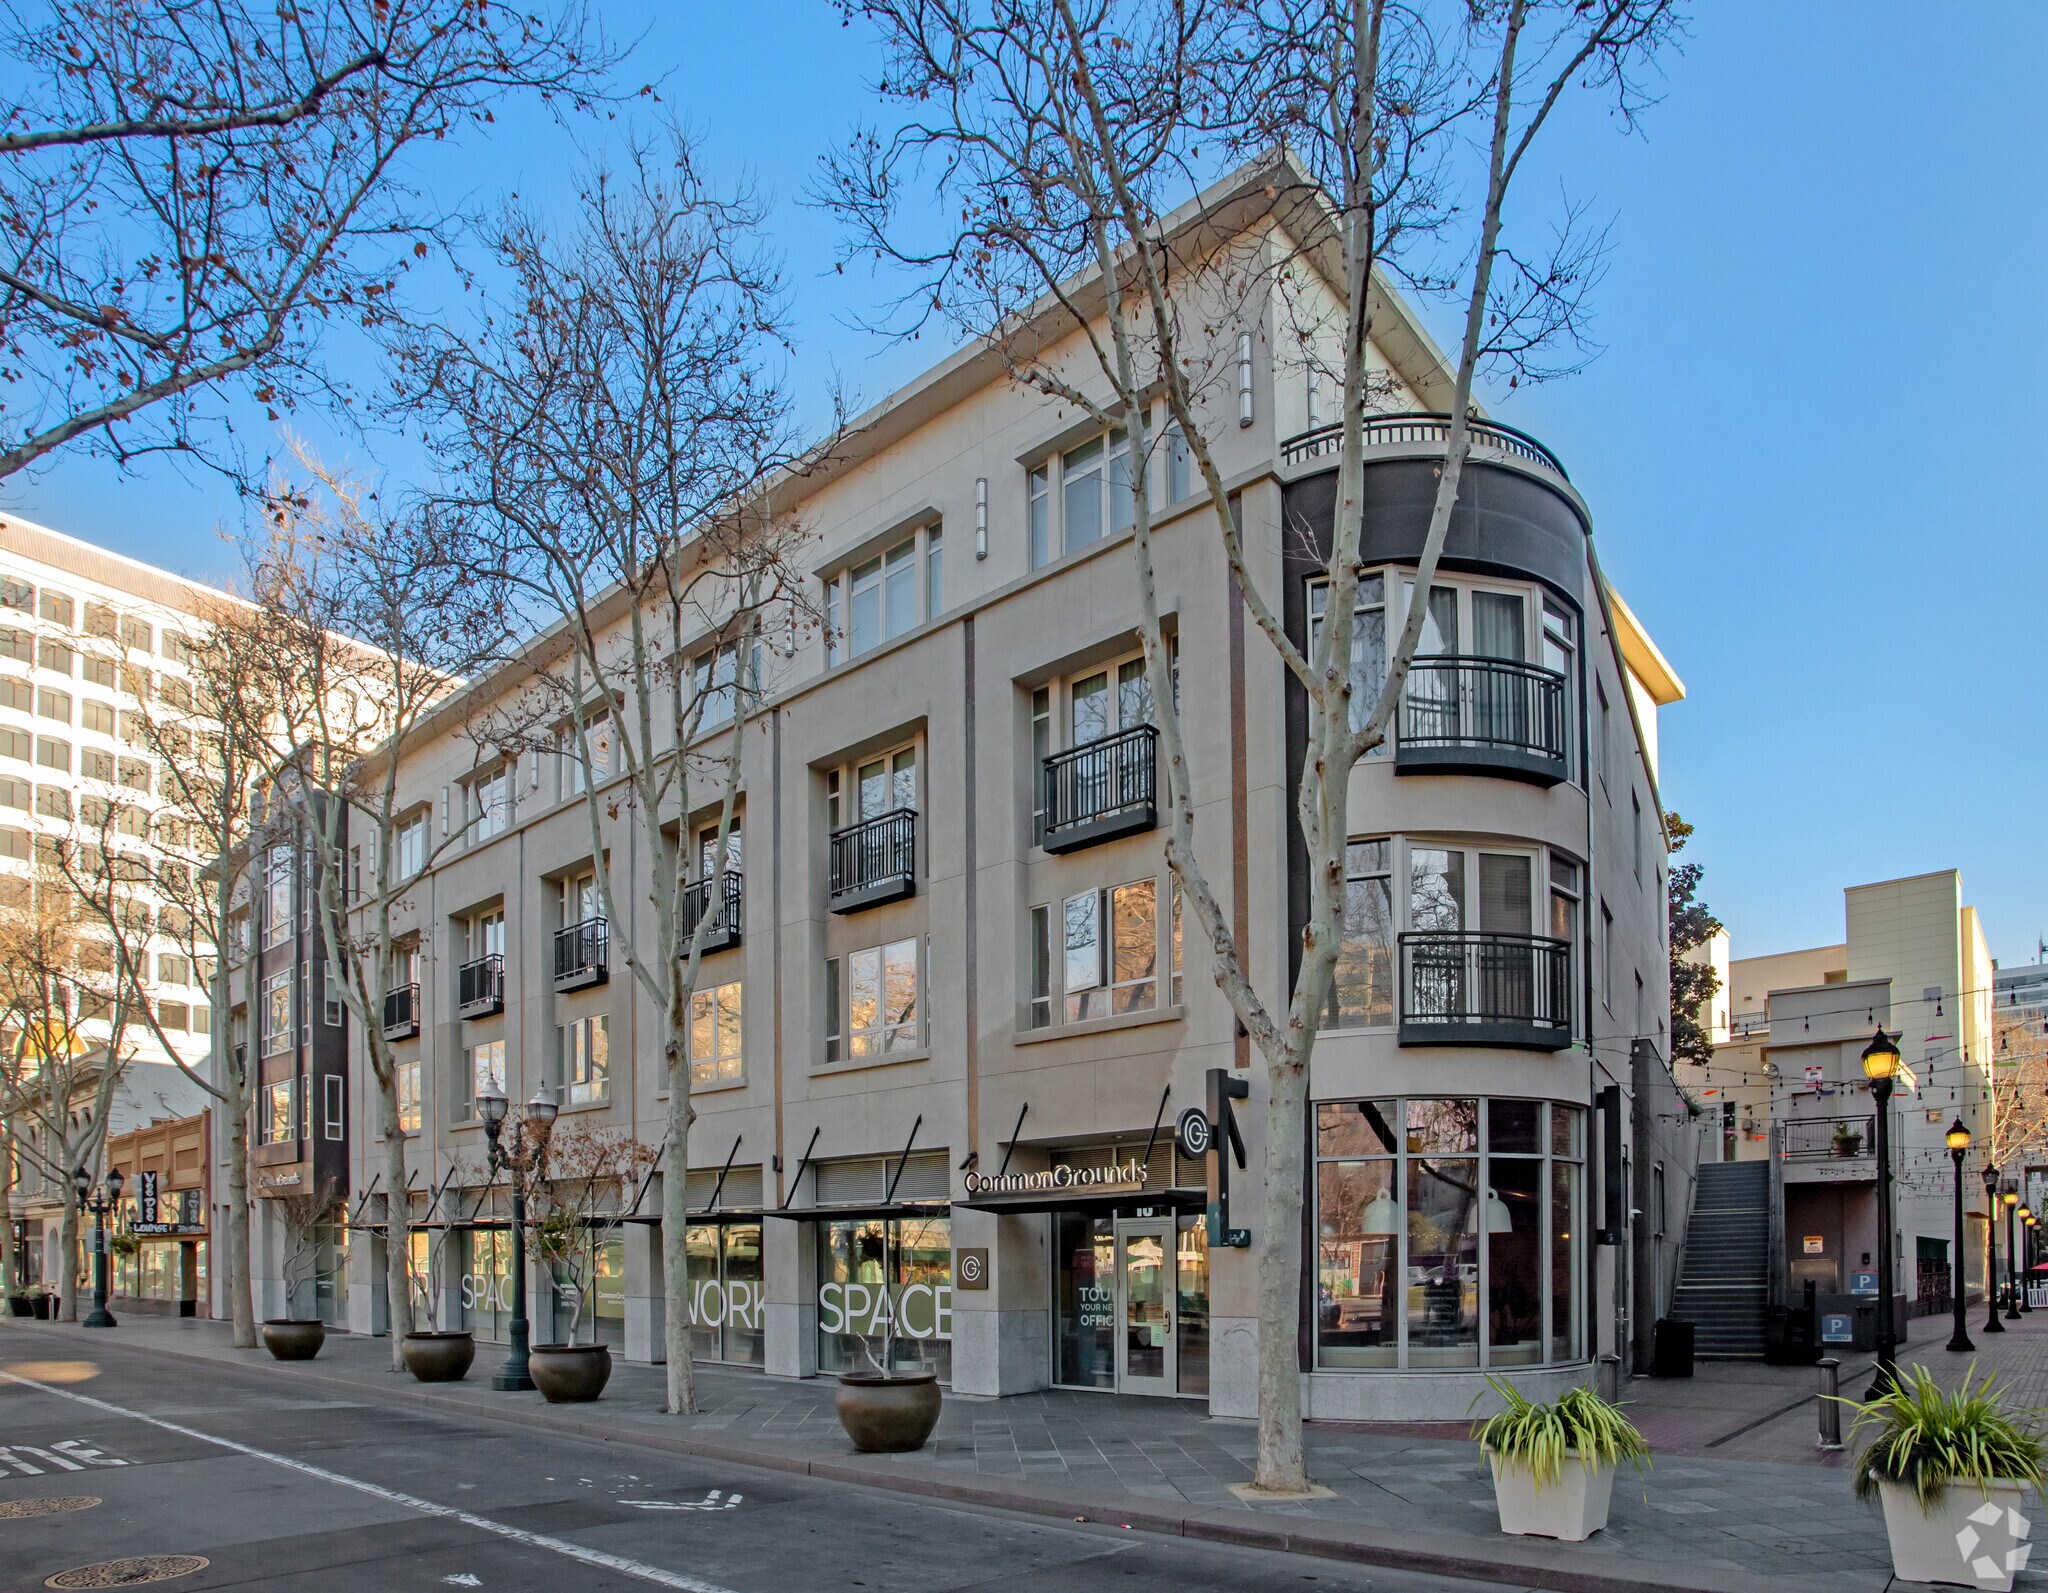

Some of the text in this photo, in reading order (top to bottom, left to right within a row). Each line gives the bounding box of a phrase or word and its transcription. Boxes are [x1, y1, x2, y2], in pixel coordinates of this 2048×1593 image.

[965, 1158, 1147, 1194] CommonGrounds
[1860, 1275, 1871, 1288] P
[1079, 1287, 1113, 1302] TOU
[819, 1282, 951, 1339] SPACE
[1831, 1320, 1843, 1334] P
